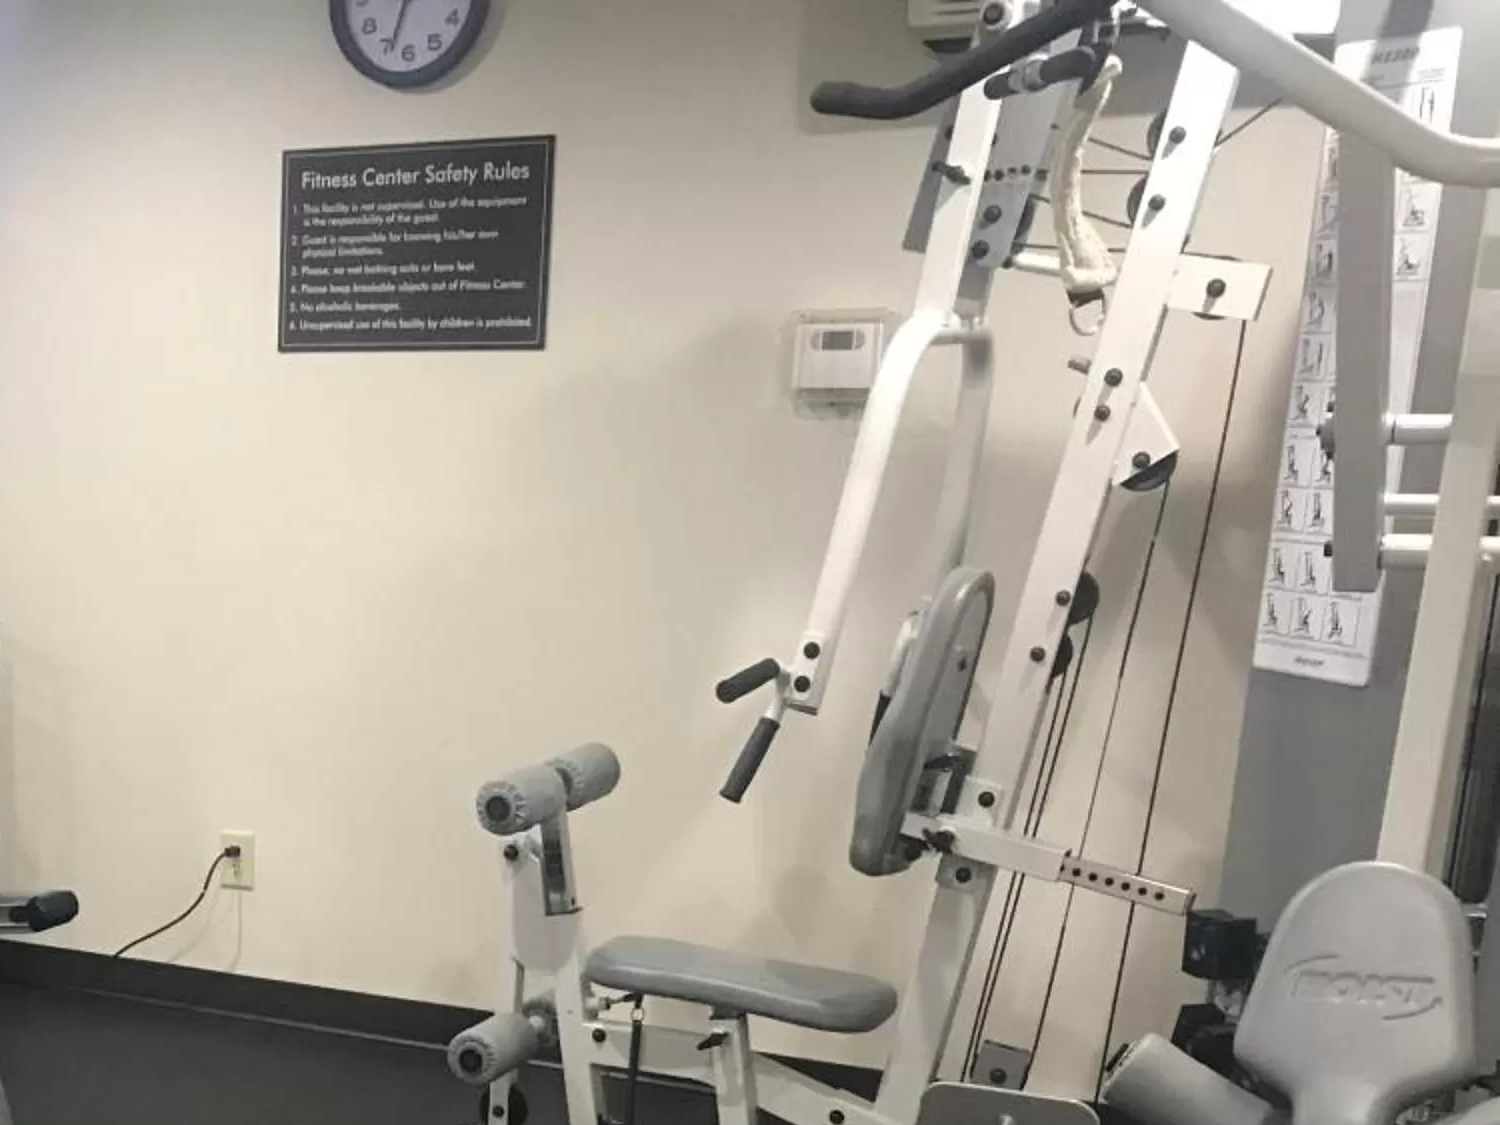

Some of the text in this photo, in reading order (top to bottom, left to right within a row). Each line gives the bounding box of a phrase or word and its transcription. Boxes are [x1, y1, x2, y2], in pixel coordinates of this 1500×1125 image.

[362, 17, 378, 36] 8
[445, 8, 460, 27] 4
[379, 37, 395, 56] 7
[427, 33, 442, 51] 5
[401, 44, 417, 62] 6
[301, 159, 530, 190] Fitness Center Safety Rules
